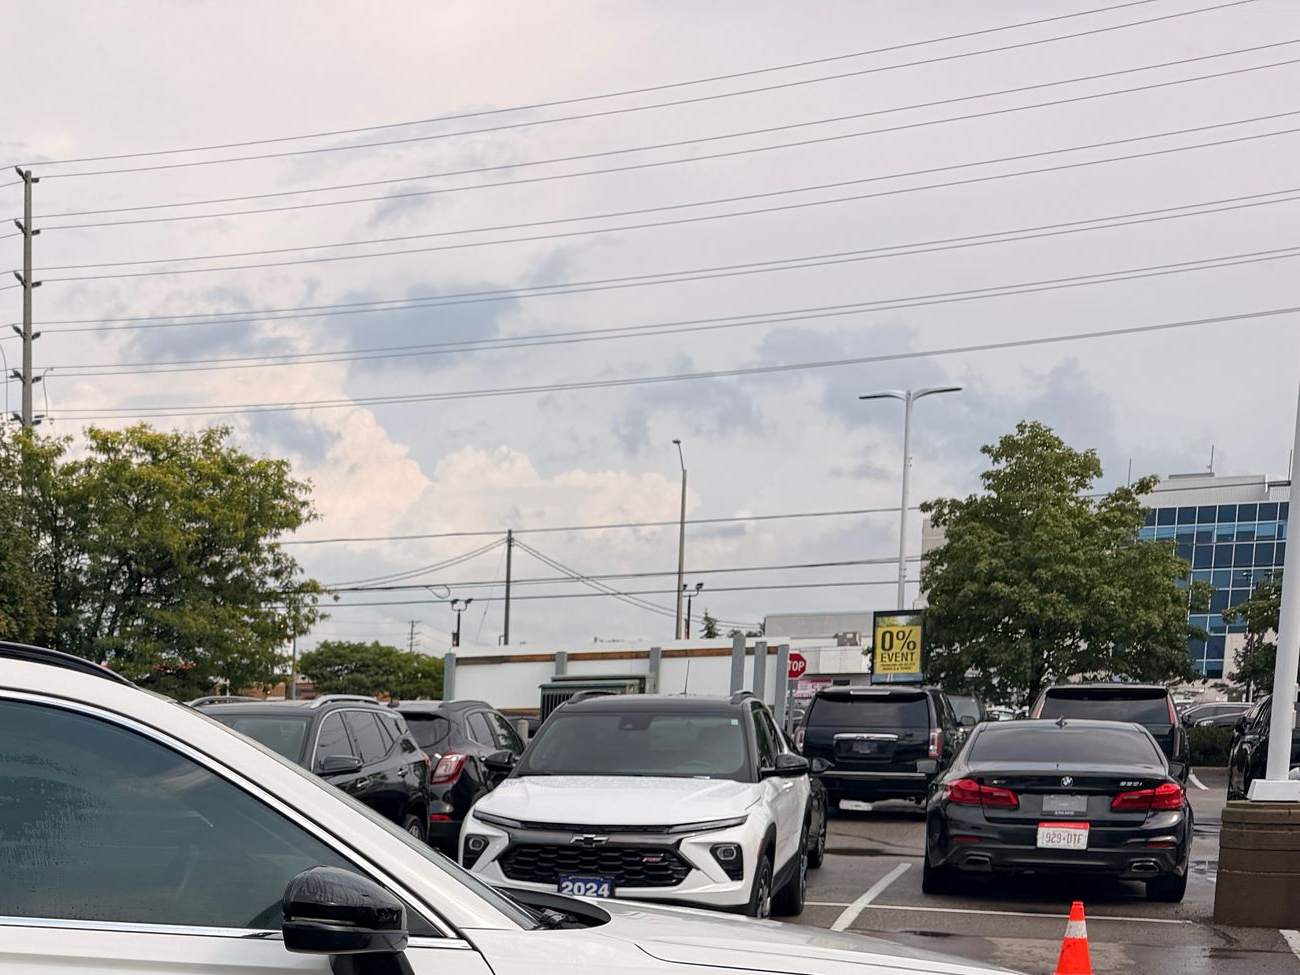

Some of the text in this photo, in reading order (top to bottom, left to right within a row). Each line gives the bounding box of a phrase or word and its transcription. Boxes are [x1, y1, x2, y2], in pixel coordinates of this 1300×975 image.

[881, 628, 917, 652] 0%
[880, 651, 915, 663] EVENT
[787, 660, 805, 671] TOP
[561, 880, 610, 897] 2024
